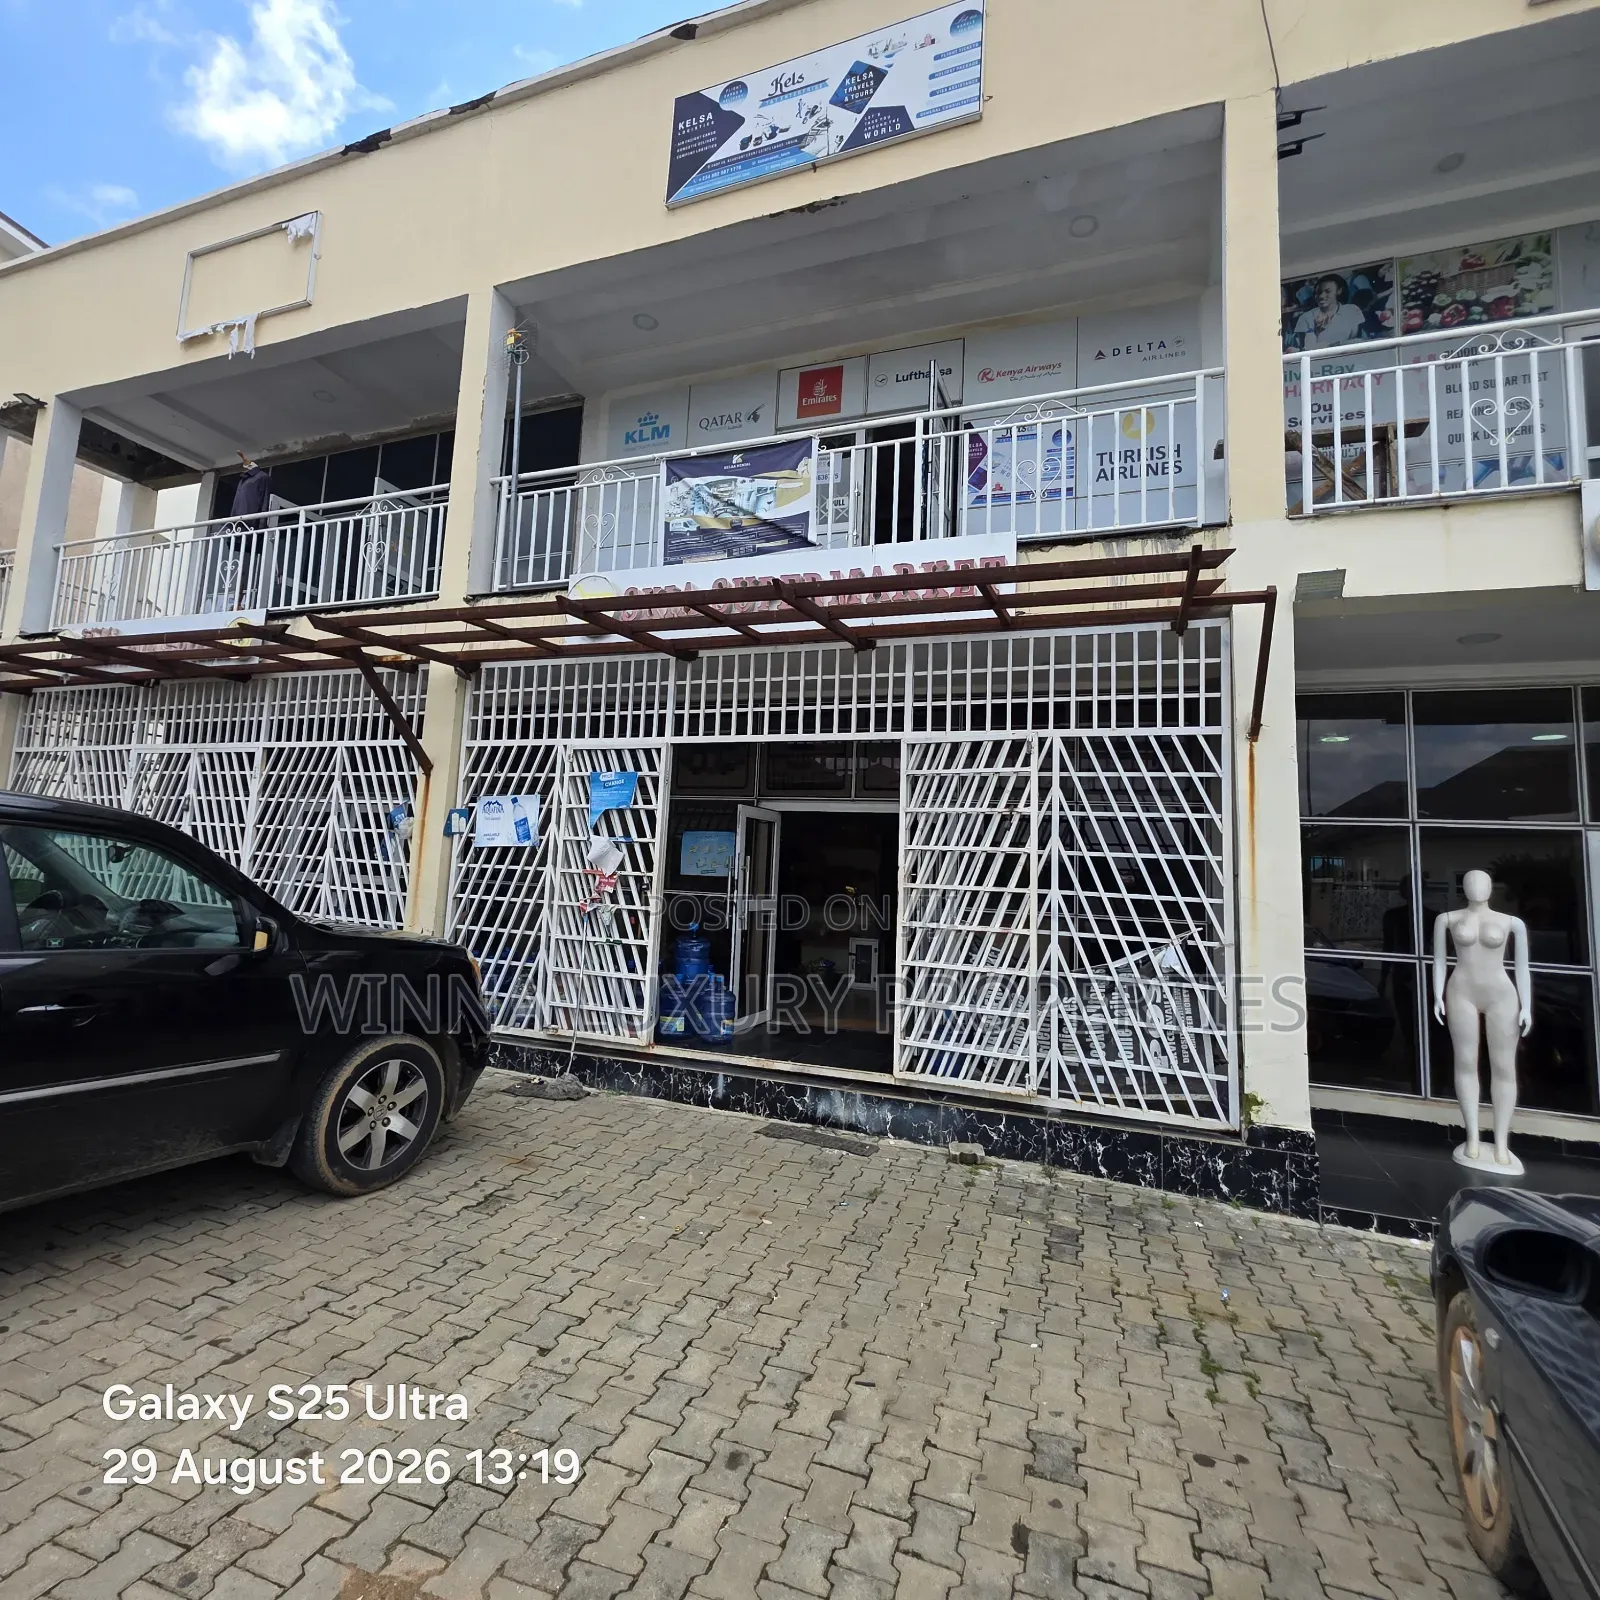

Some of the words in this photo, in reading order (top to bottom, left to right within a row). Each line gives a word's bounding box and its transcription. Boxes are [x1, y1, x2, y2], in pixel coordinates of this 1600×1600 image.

[845, 71, 874, 85] KELSA
[844, 80, 874, 94] TRAVELS
[851, 88, 874, 100] TOURS
[678, 112, 713, 130] KELSA
[863, 123, 901, 140] WORLD
[1112, 340, 1167, 358] DELTA
[895, 367, 952, 383] Lufthasa
[996, 368, 1023, 378] Kenya
[1024, 362, 1062, 373] Airways
[1445, 381, 1480, 394] BLOD
[1483, 375, 1518, 390] SUAR
[1522, 371, 1549, 383] TT
[802, 394, 837, 406] Emirates
[1310, 402, 1333, 413] Ou
[1287, 410, 1366, 428] Srvies
[1446, 404, 1493, 420] REING
[699, 411, 742, 431] QATAR
[625, 424, 671, 445] KLM
[1448, 431, 1480, 445] QUIK
[1483, 424, 1546, 439] DEVERIS
[830, 498, 845, 507] ULL
[604, 778, 625, 787] CHANGE
[1182, 989, 1192, 1019] MONEY
